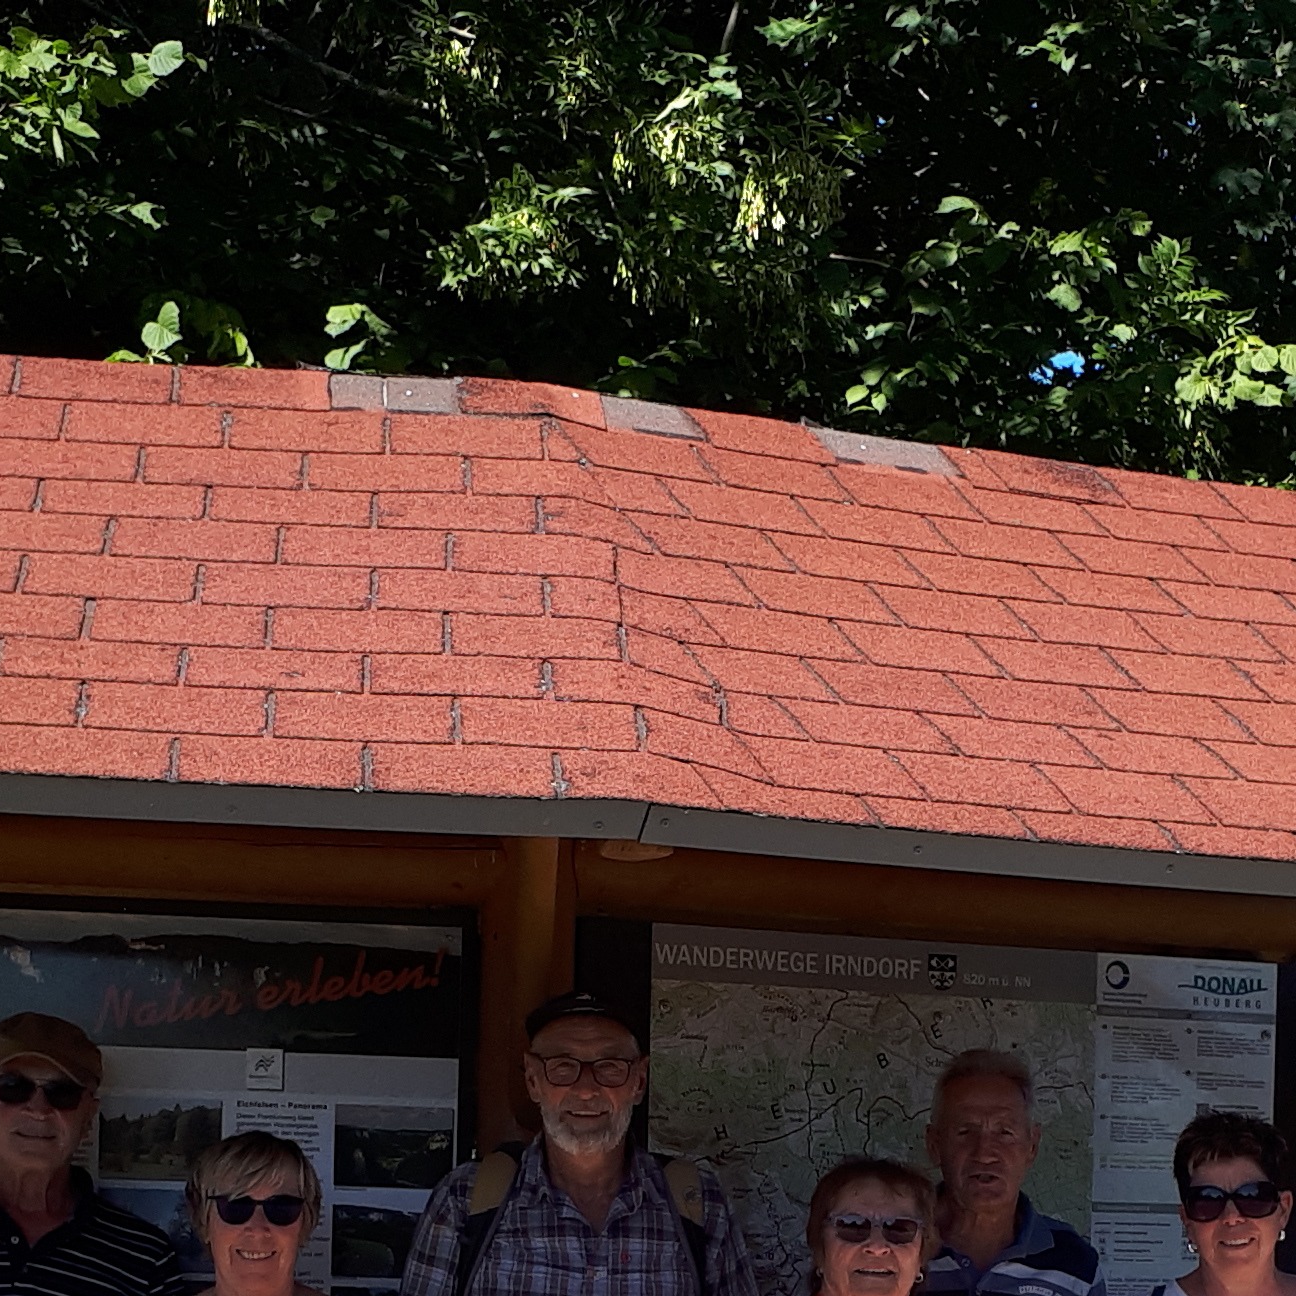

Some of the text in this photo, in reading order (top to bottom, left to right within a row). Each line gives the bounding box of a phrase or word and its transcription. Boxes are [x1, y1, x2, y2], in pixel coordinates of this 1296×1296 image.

[655, 942, 818, 975] WANDERWEGE
[825, 954, 922, 981] IRNDORF
[1014, 975, 1032, 988] NN
[94, 946, 449, 1033] Natur erleben!
[1193, 974, 1263, 995] DONAU
[1192, 996, 1262, 1009] HEUBERG
